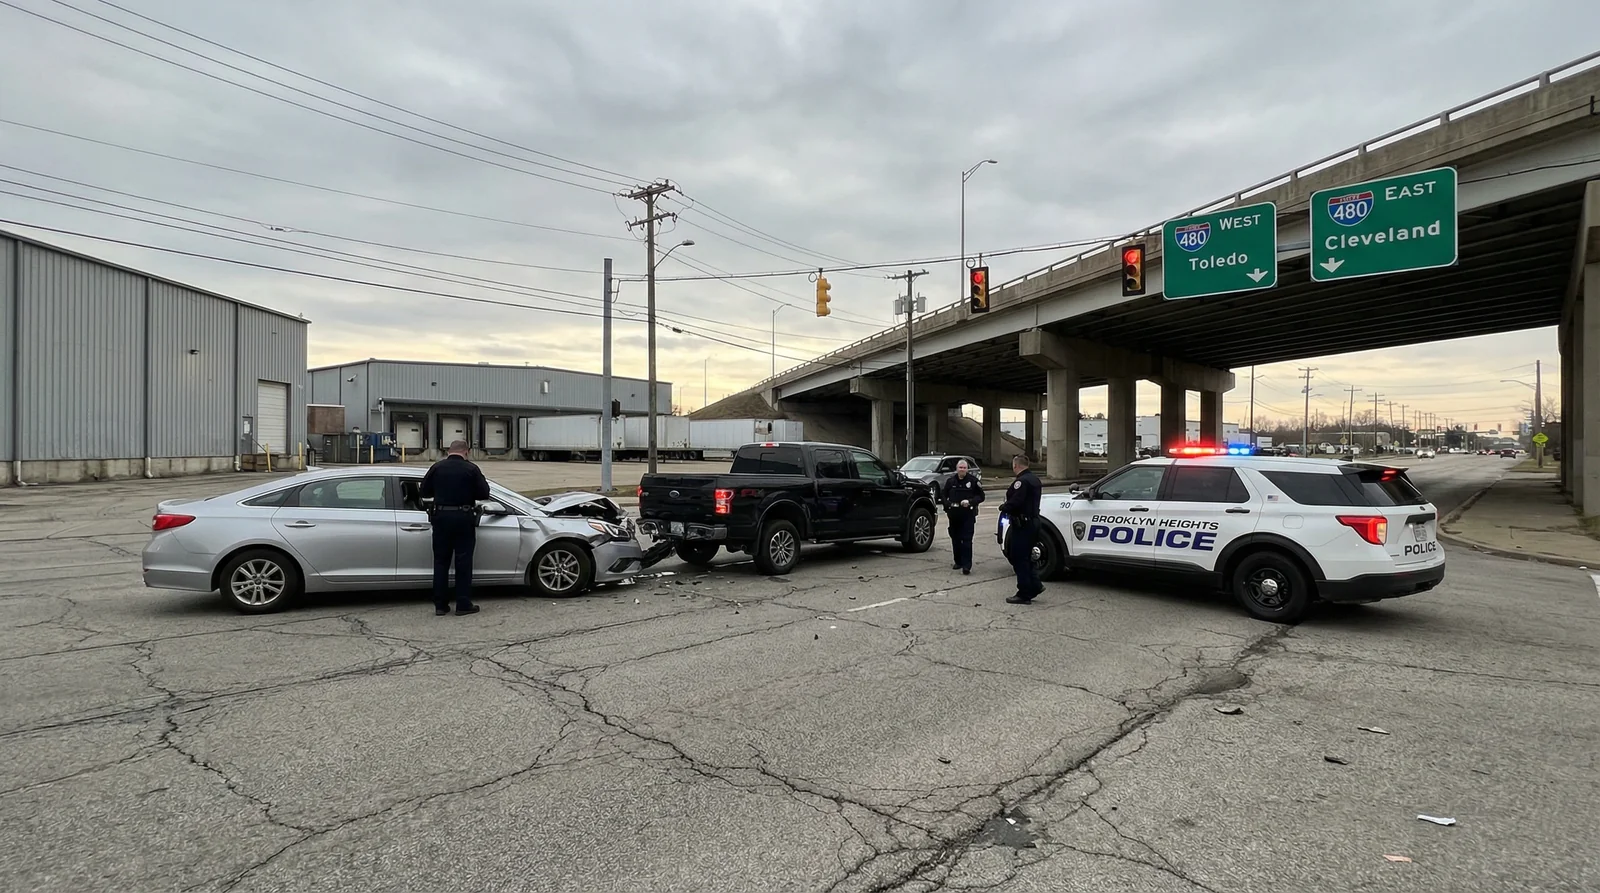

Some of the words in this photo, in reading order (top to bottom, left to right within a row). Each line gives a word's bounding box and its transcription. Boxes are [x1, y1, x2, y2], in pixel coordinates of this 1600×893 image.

[1333, 201, 1368, 220] 480
[1385, 181, 1436, 201] EAST
[1180, 231, 1206, 247] 480
[1219, 214, 1261, 231] WEST
[1325, 220, 1440, 250] Cleveland
[1189, 252, 1248, 271] Toledo
[1091, 515, 1156, 526] BROOKLYN
[1159, 518, 1219, 530] HEIGHTS
[1087, 525, 1218, 551] POLICE
[1404, 541, 1436, 556] POLICE
